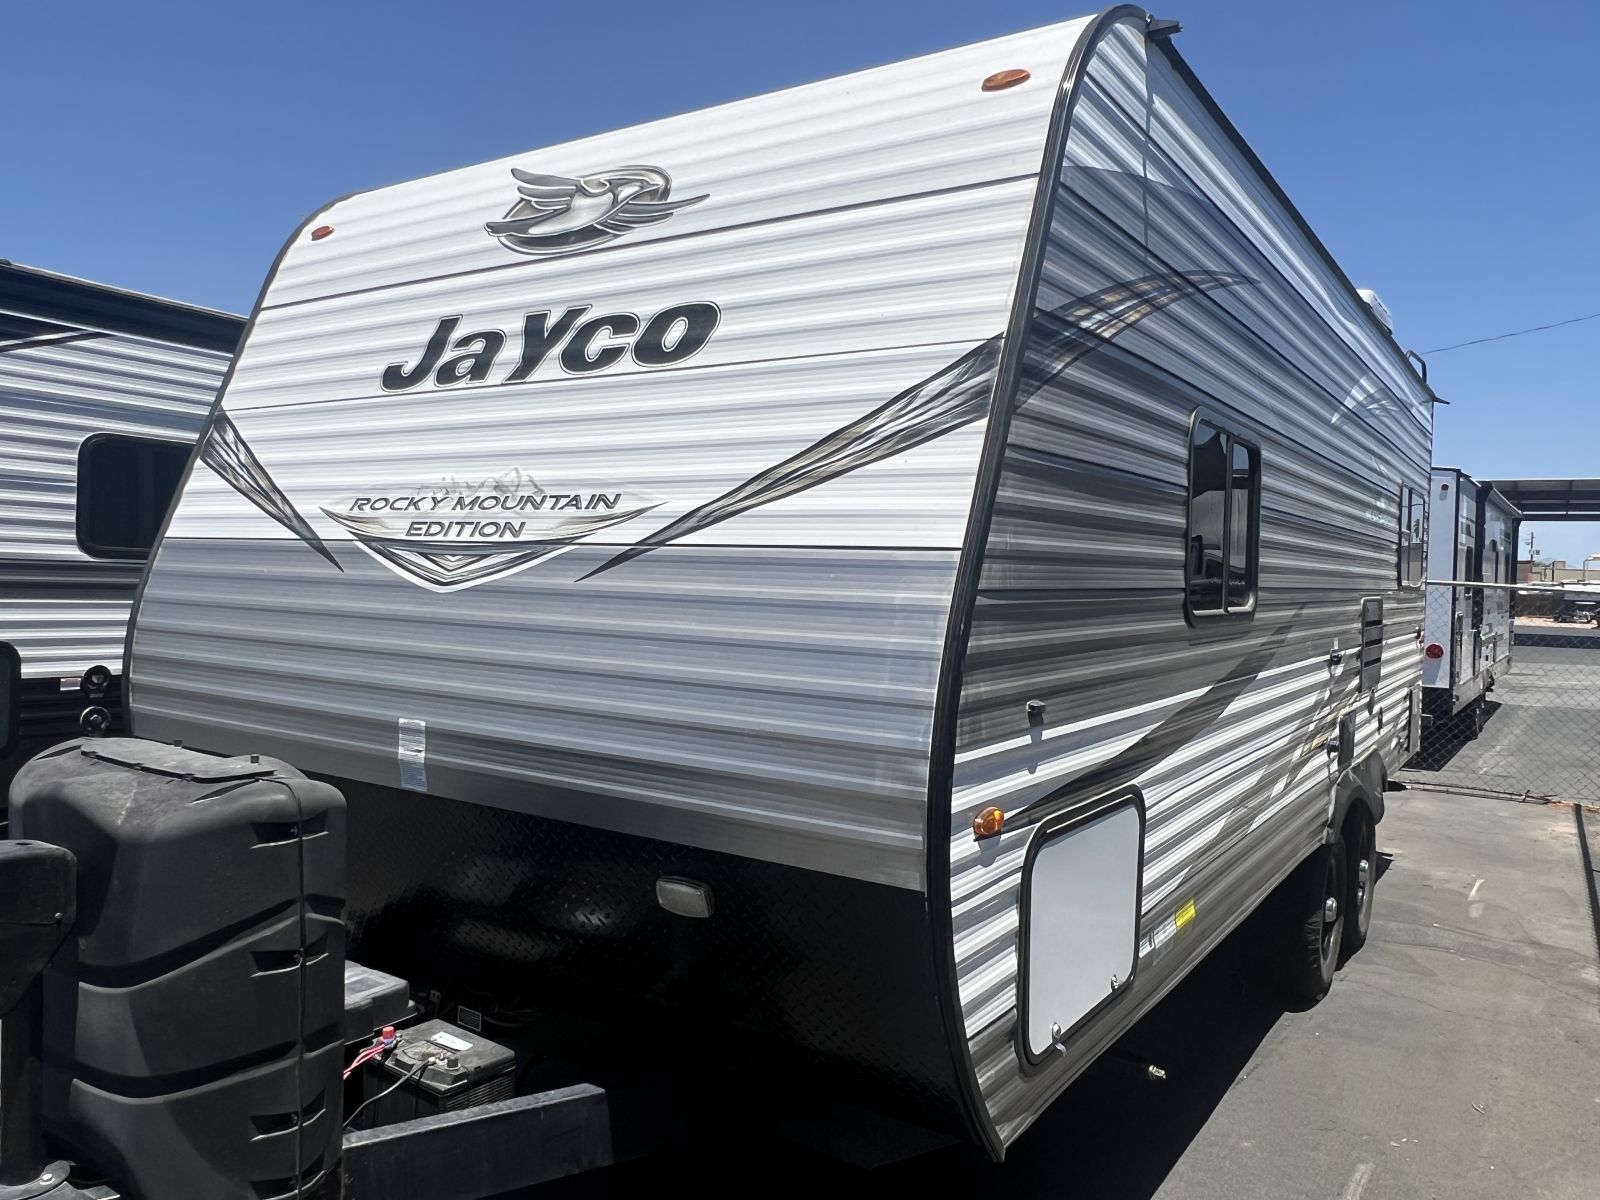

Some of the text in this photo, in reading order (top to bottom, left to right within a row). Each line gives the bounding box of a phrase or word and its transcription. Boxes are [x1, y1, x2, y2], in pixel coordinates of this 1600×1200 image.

[349, 493, 622, 512] ROCKY MOUNTAIN
[404, 521, 526, 539] EDITION
